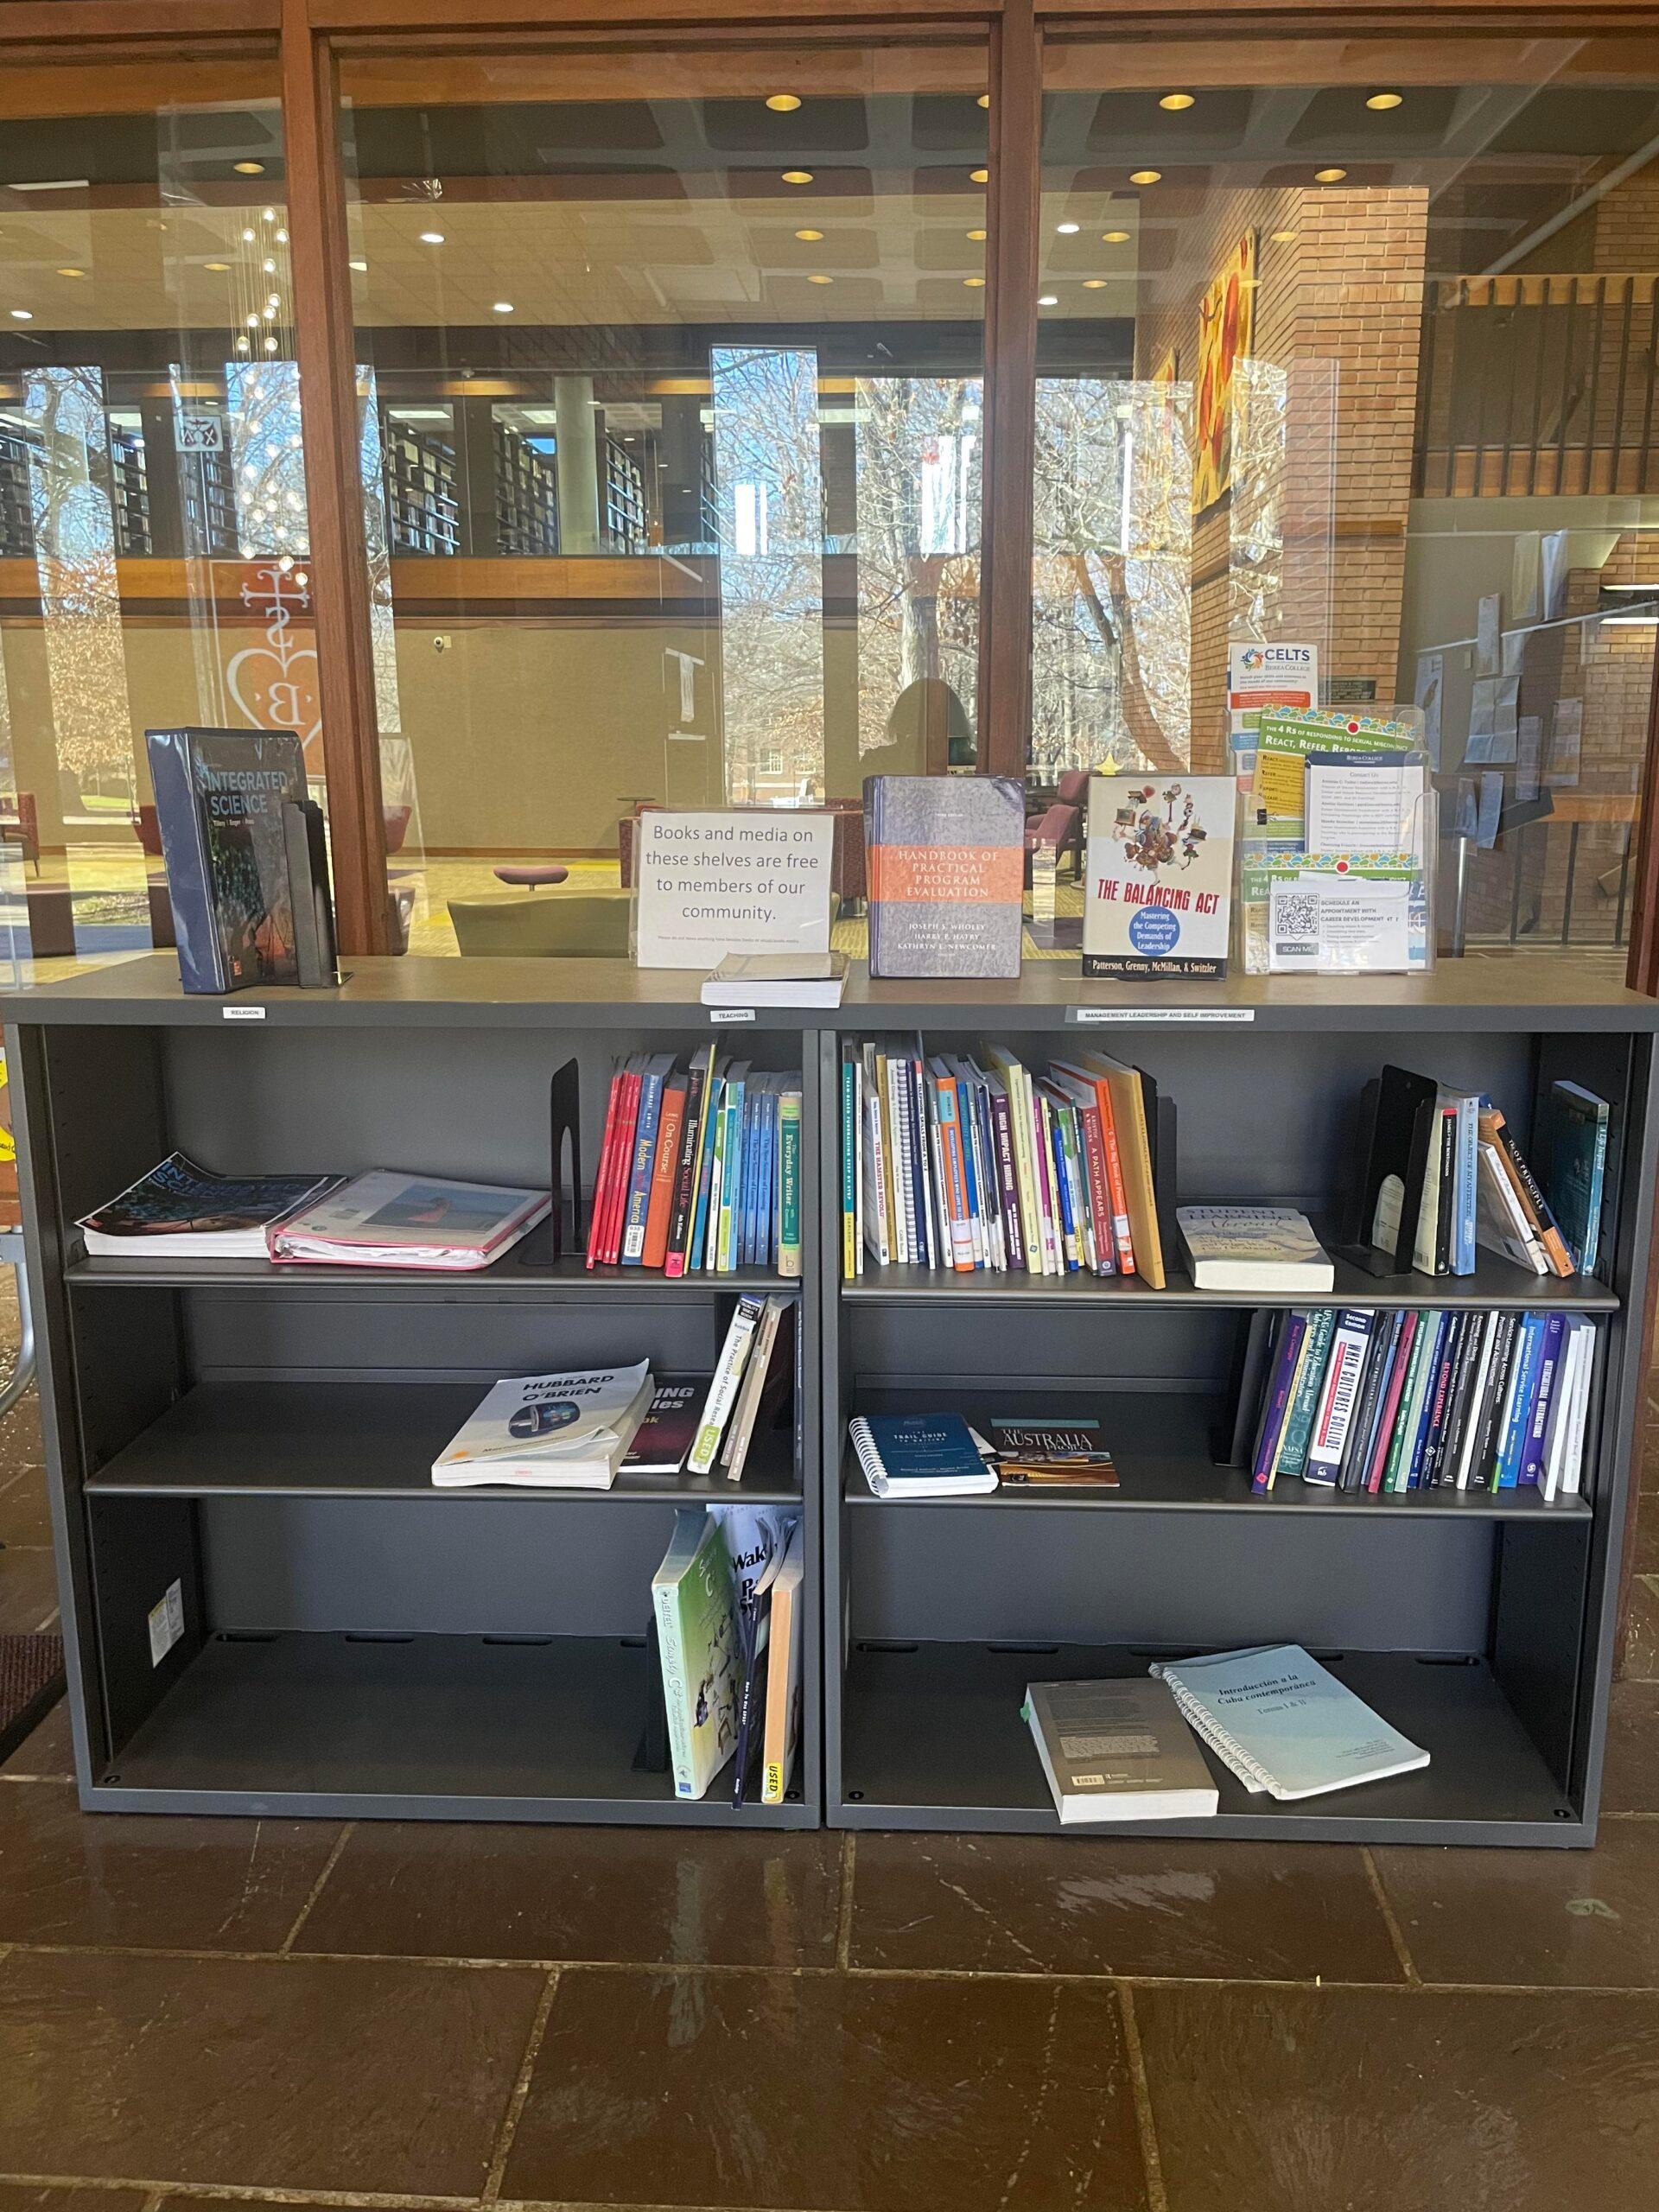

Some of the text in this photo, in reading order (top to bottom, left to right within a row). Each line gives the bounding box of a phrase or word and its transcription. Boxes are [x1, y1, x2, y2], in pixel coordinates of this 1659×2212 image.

[1264, 649, 1310, 661] CELTS
[1278, 725, 1285, 734] 4
[1306, 732, 1343, 742] RESPONDING
[1352, 737, 1373, 747] SEXUAL
[207, 771, 289, 791] INTEGRATED
[211, 794, 268, 816] SCIENCE
[653, 825, 813, 843] Books and media on
[645, 851, 819, 868] these shelves are free
[899, 850, 999, 861] HANDBOOK OF
[912, 863, 985, 873] PRACTICAL
[657, 879, 806, 895] to members of our
[916, 875, 981, 885] PROGRAM
[906, 887, 989, 897] EVALUATION
[1097, 879, 1220, 914] THE BALANCING ACT
[682, 906, 777, 924] community.
[1141, 912, 1170, 922] Mastering
[1145, 922, 1176, 932] Competing
[1138, 943, 1170, 952] Leadership
[1092, 959, 1122, 971] Patterson,
[1125, 960, 1150, 974] Grenny,
[1152, 961, 1182, 973] McMillan,
[1190, 962, 1217, 974] Switzler
[665, 1123, 676, 1139] On
[1597, 1134, 1606, 1145] Life
[660, 1140, 674, 1173] Course
[784, 1134, 793, 1175] Everyday
[998, 1111, 1014, 1191] HIGH IMPACT HIRING
[1595, 1147, 1605, 1170] Inspired
[678, 1120, 698, 1208] Illuminating Social Life
[875, 1157, 884, 1191] HAMSTER
[1092, 1154, 1102, 1177] PATH
[1111, 1161, 1120, 1177] Book
[630, 1139, 653, 1224] Modern America
[785, 1177, 793, 1205] Writer
[847, 1175, 851, 1185] BY
[1513, 1150, 1522, 1162] OZ
[1520, 1164, 1545, 1210] PRINCIPLE
[1094, 1179, 1105, 1217] APPEARS
[1345, 1314, 1367, 1324] SECOND
[1471, 1316, 1484, 1337] Knowing
[1495, 1316, 1506, 1338] Promise
[1286, 1325, 1300, 1361] Basic Concepts
[1318, 1329, 1328, 1348] Guide
[1408, 1347, 1421, 1378] INTERCULTURAL
[1471, 1346, 1480, 1362] Doing
[1494, 1318, 1517, 1406] Service-Learning Across Cultures:
[715, 1335, 742, 1405] The Practice of Social
[1306, 1356, 1321, 1387] Education
[1487, 1351, 1501, 1387] Achievement
[1511, 1326, 1536, 1423] International Service Learning
[522, 1375, 614, 1391] HUBBARD
[522, 1387, 601, 1402] O'BRIEN
[1300, 1389, 1313, 1412] Abroad
[1325, 1344, 1363, 1452] WHEN CULTURES COLLIDE
[1432, 1363, 1451, 1428] BEYOND EXPERIENCE
[1533, 1359, 1554, 1439] INTERCULTURAL INTERACTIONS
[701, 1430, 717, 1456] USED
[1003, 1433, 1093, 1447] AUSTRALIA
[661, 1599, 679, 1676] DEITEL Simply
[1218, 1678, 1279, 1696] Introducción
[1217, 1695, 1244, 1705] Cuba
[768, 1764, 779, 1793] USED
